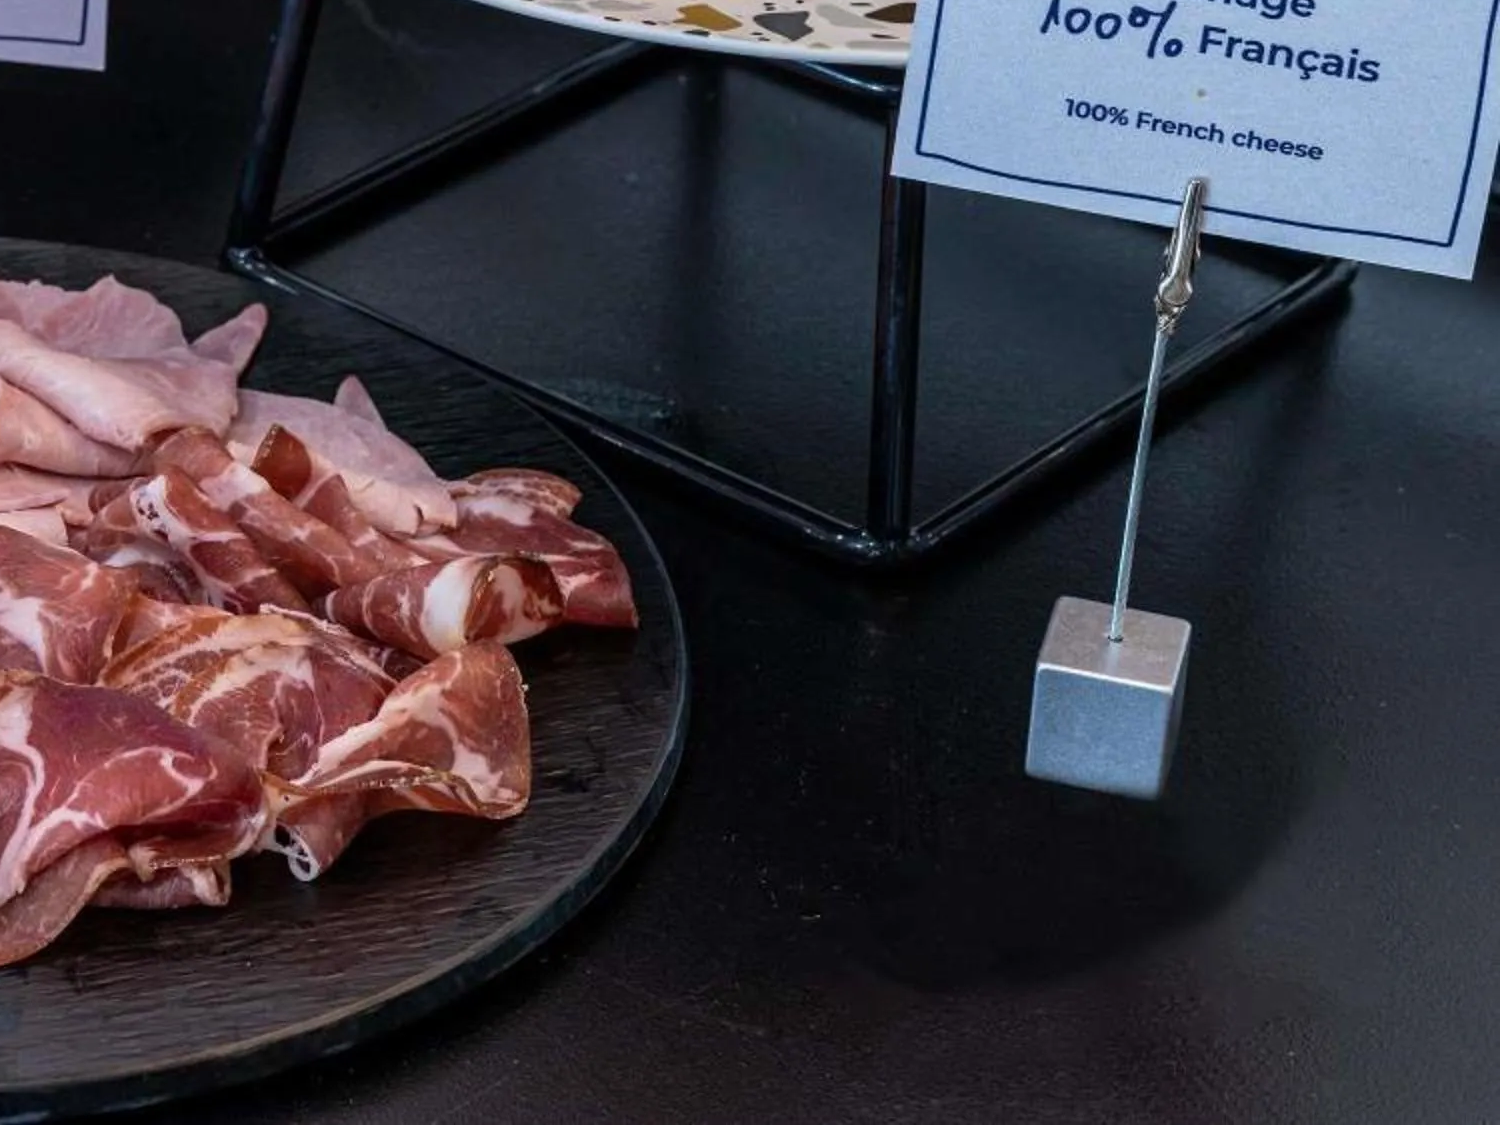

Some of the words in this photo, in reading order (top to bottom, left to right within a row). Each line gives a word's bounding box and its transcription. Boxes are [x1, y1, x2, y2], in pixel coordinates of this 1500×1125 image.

[1198, 25, 1381, 83] Français
[1064, 98, 1129, 127] 100%
[1136, 111, 1225, 144] French
[1232, 128, 1325, 161] cheese
